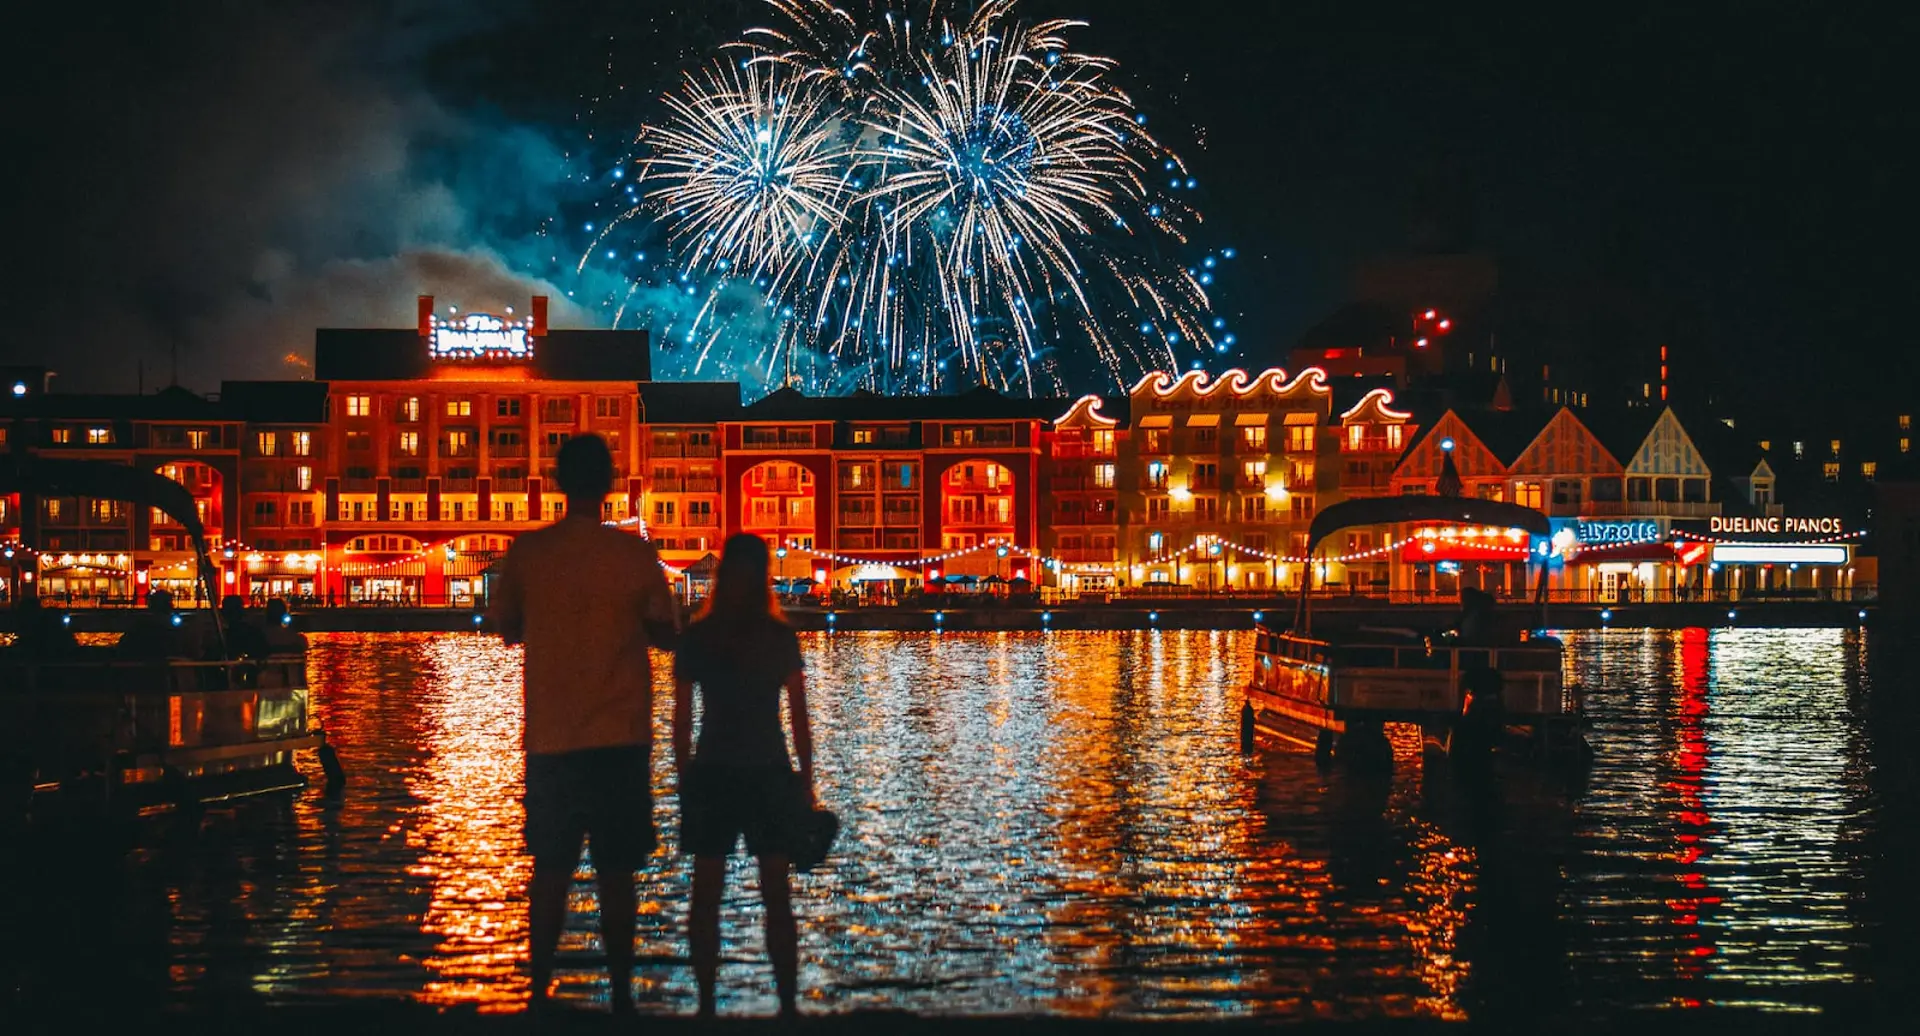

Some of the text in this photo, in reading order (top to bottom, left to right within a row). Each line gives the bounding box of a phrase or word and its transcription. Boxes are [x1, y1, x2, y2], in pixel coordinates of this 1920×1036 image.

[1576, 521, 1658, 542] ELLYROLLS
[1710, 516, 1842, 534] DUELING PIANOS
